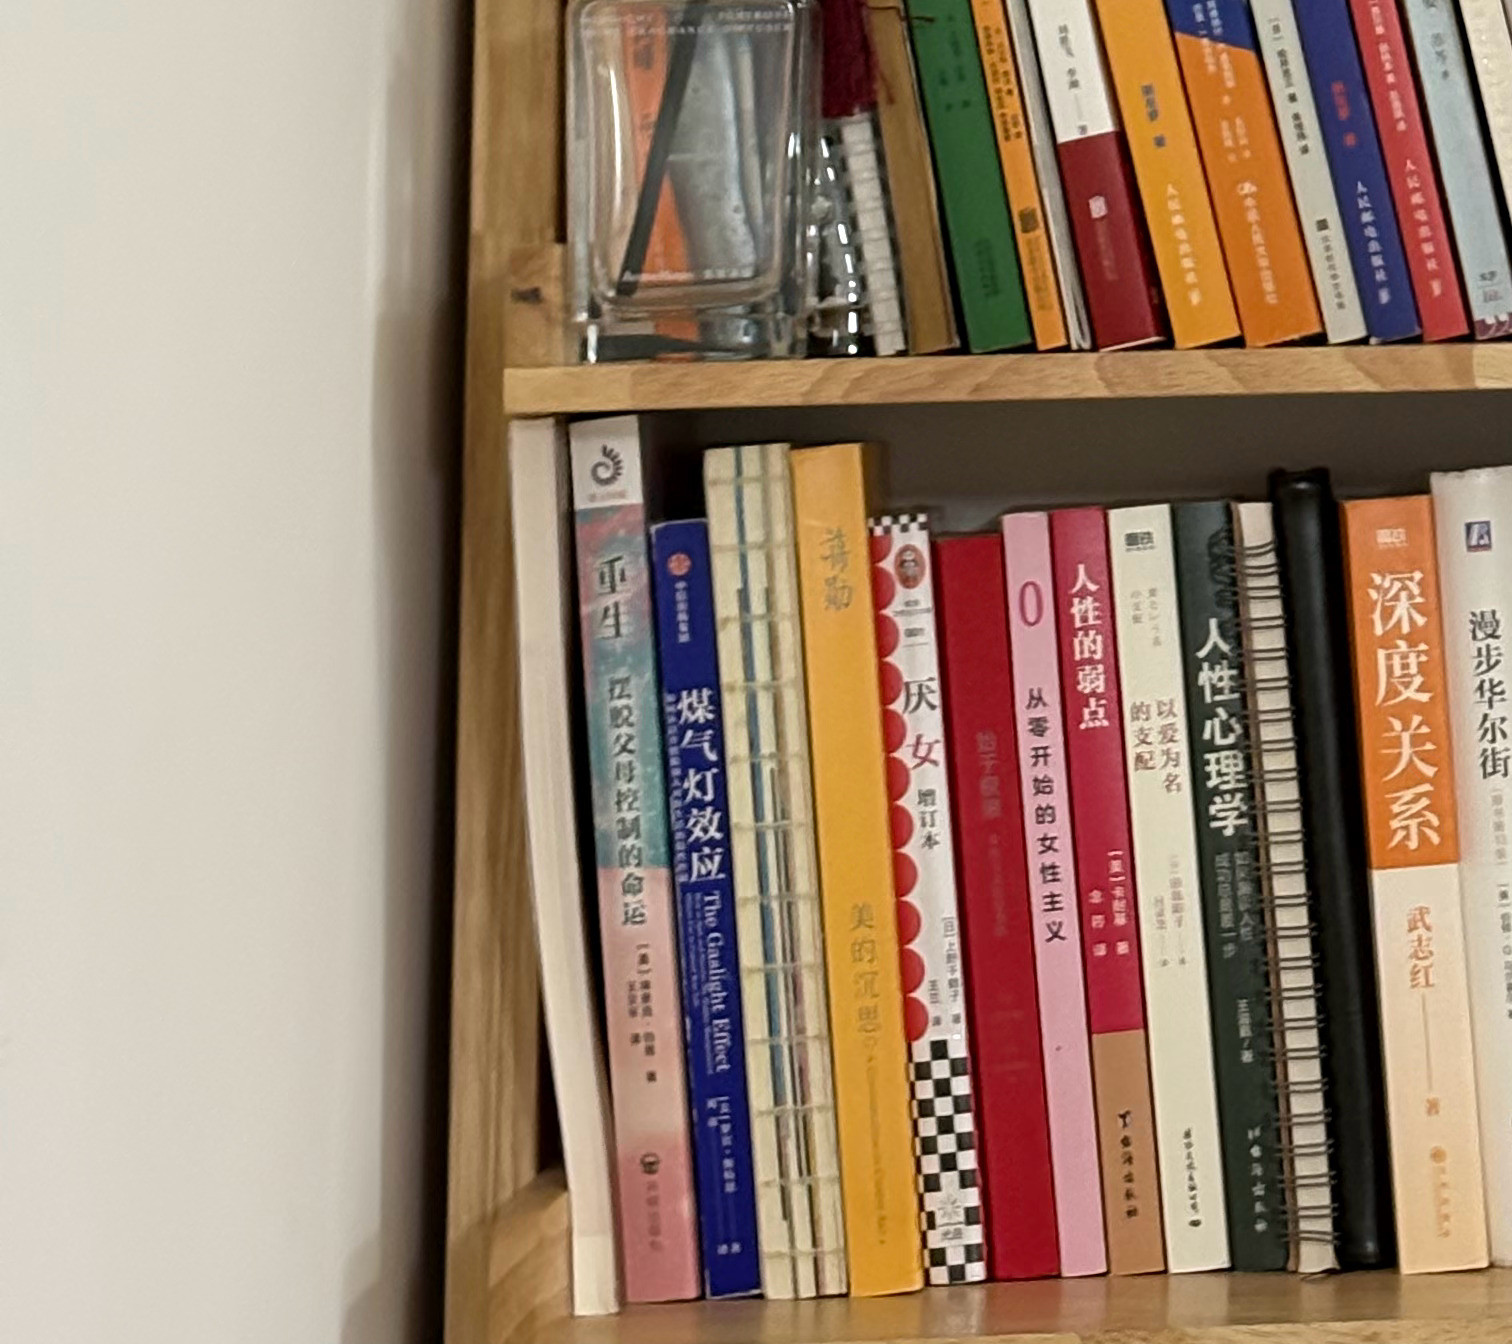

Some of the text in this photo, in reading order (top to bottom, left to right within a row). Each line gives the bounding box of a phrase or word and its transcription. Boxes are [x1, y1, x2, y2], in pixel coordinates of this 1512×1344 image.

[902, 676, 942, 770] 厌女
[1069, 563, 1110, 730] 人性的弱点
[1195, 617, 1250, 837] 人性心理学
[1367, 569, 1441, 851] 深度关系
[1468, 608, 1512, 781] 漫步华尔街
[677, 686, 727, 883] 煤气灯效应
[917, 787, 942, 850] 增订本
[1024, 687, 1068, 944] 从零开始的女性主义
[1129, 701, 1156, 772] 的支配
[1155, 700, 1183, 794] 以爱为名
[701, 889, 733, 1075] The Gaslight Effect
[849, 902, 882, 1036] 美的沉思
[1406, 905, 1436, 990] 武志红
